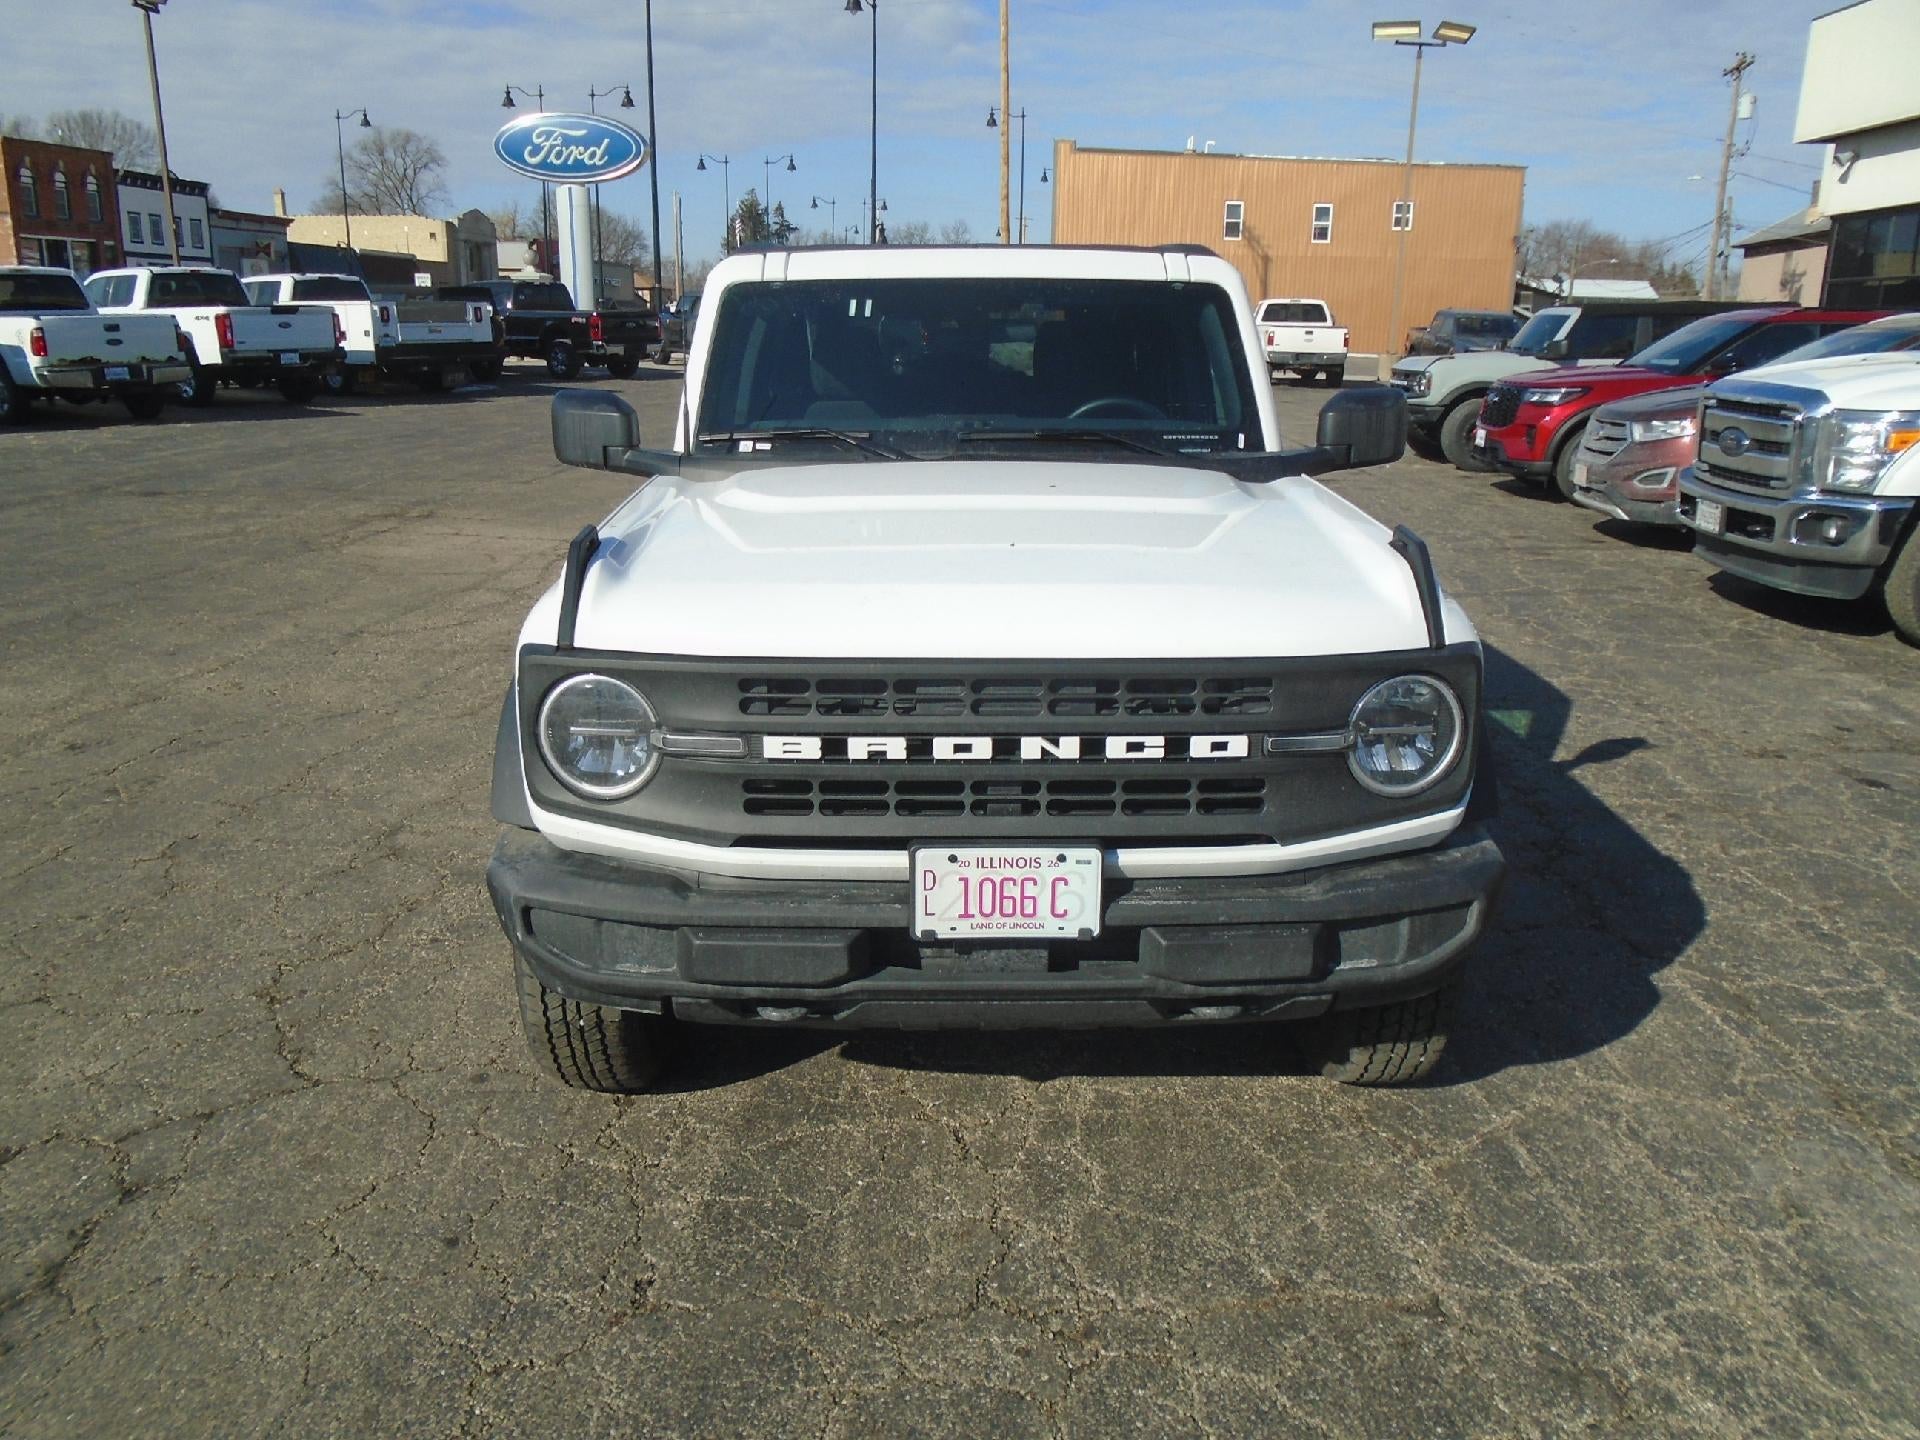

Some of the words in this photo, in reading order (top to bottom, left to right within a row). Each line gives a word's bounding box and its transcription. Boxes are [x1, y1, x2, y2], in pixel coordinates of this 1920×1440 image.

[524, 127, 610, 165] Ford
[763, 735, 1249, 760] BRONCO
[958, 860, 971, 868] 20
[976, 857, 1042, 869] ILLINOIS
[1047, 860, 1060, 868] 26
[957, 876, 1039, 919] 1066
[1050, 876, 1069, 919] C
[970, 922, 994, 930] LAND
[995, 922, 1007, 930] OF
[1008, 922, 1045, 931] LINCOLN
